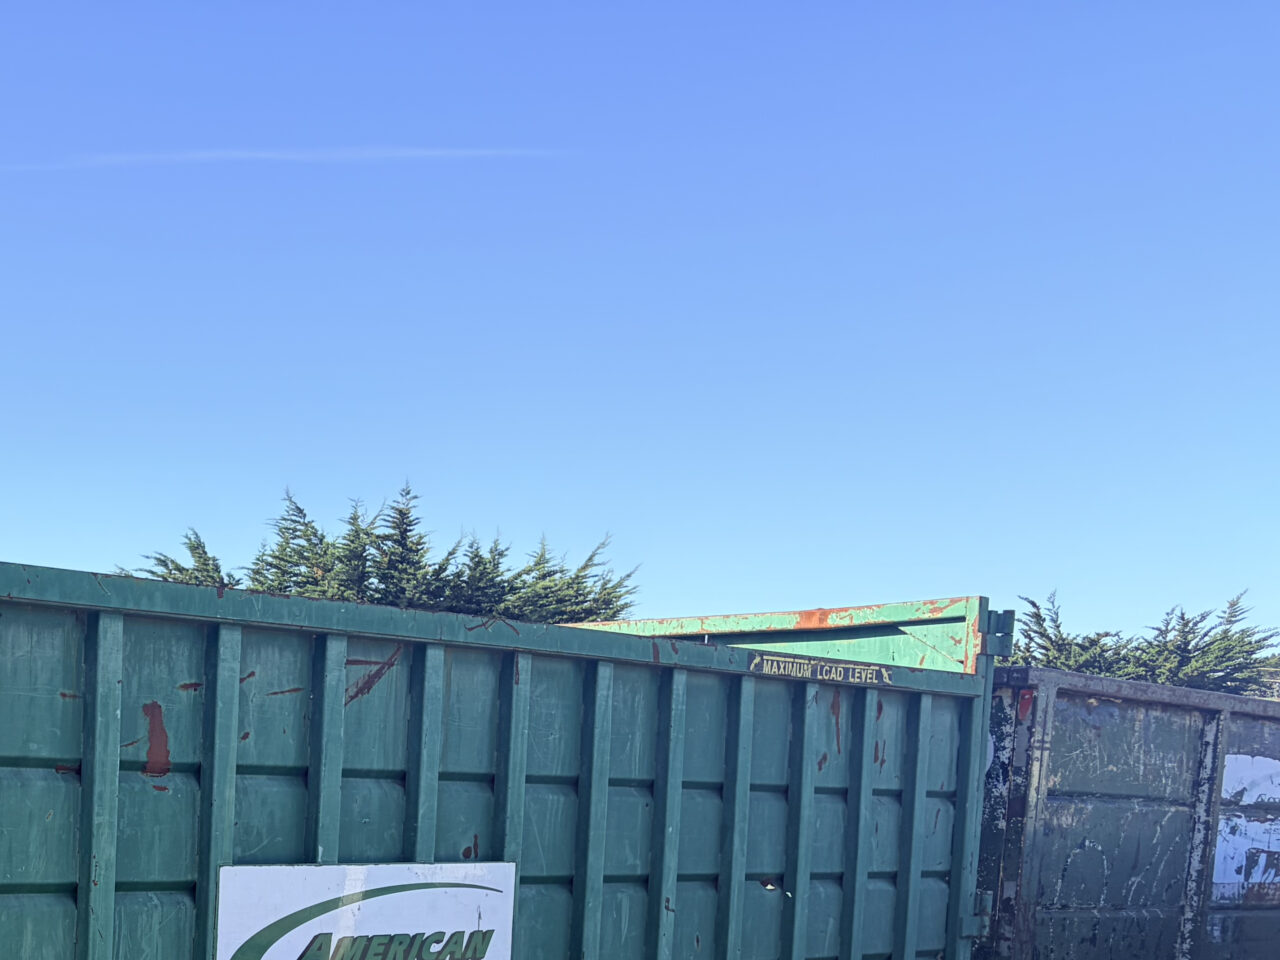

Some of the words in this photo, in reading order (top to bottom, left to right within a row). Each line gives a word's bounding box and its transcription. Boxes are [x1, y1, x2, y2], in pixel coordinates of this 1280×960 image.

[763, 660, 812, 677] MAXIMUM
[817, 665, 844, 681] LOAD
[849, 669, 878, 684] LEVEL
